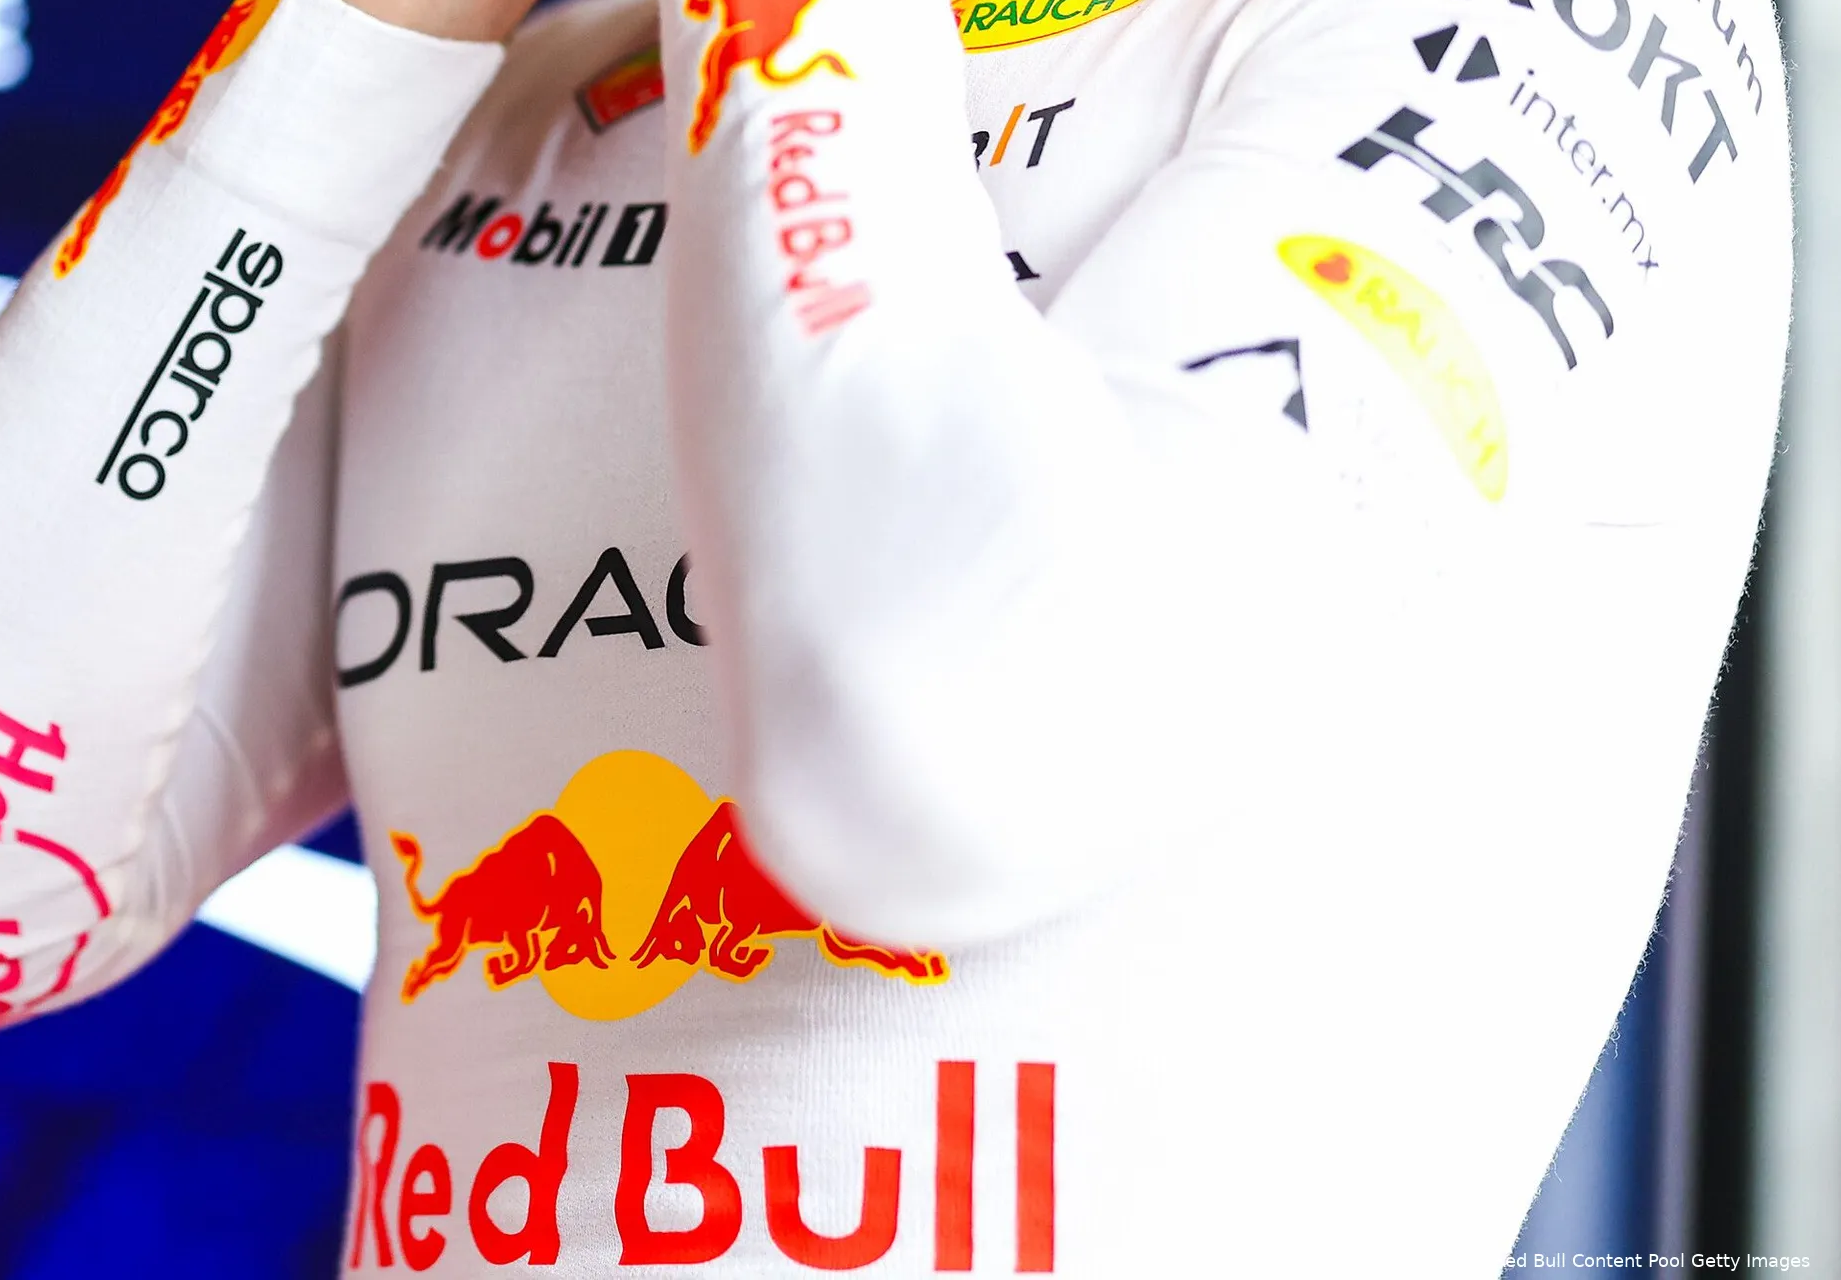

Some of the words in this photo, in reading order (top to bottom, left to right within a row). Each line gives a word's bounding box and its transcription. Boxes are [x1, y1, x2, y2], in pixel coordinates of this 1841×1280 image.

[420, 192, 611, 269] Mobil
[1508, 67, 1660, 283] inter.mx
[108, 234, 284, 501] sparco
[349, 1060, 579, 1272] Red
[614, 1060, 1056, 1272] Bull
